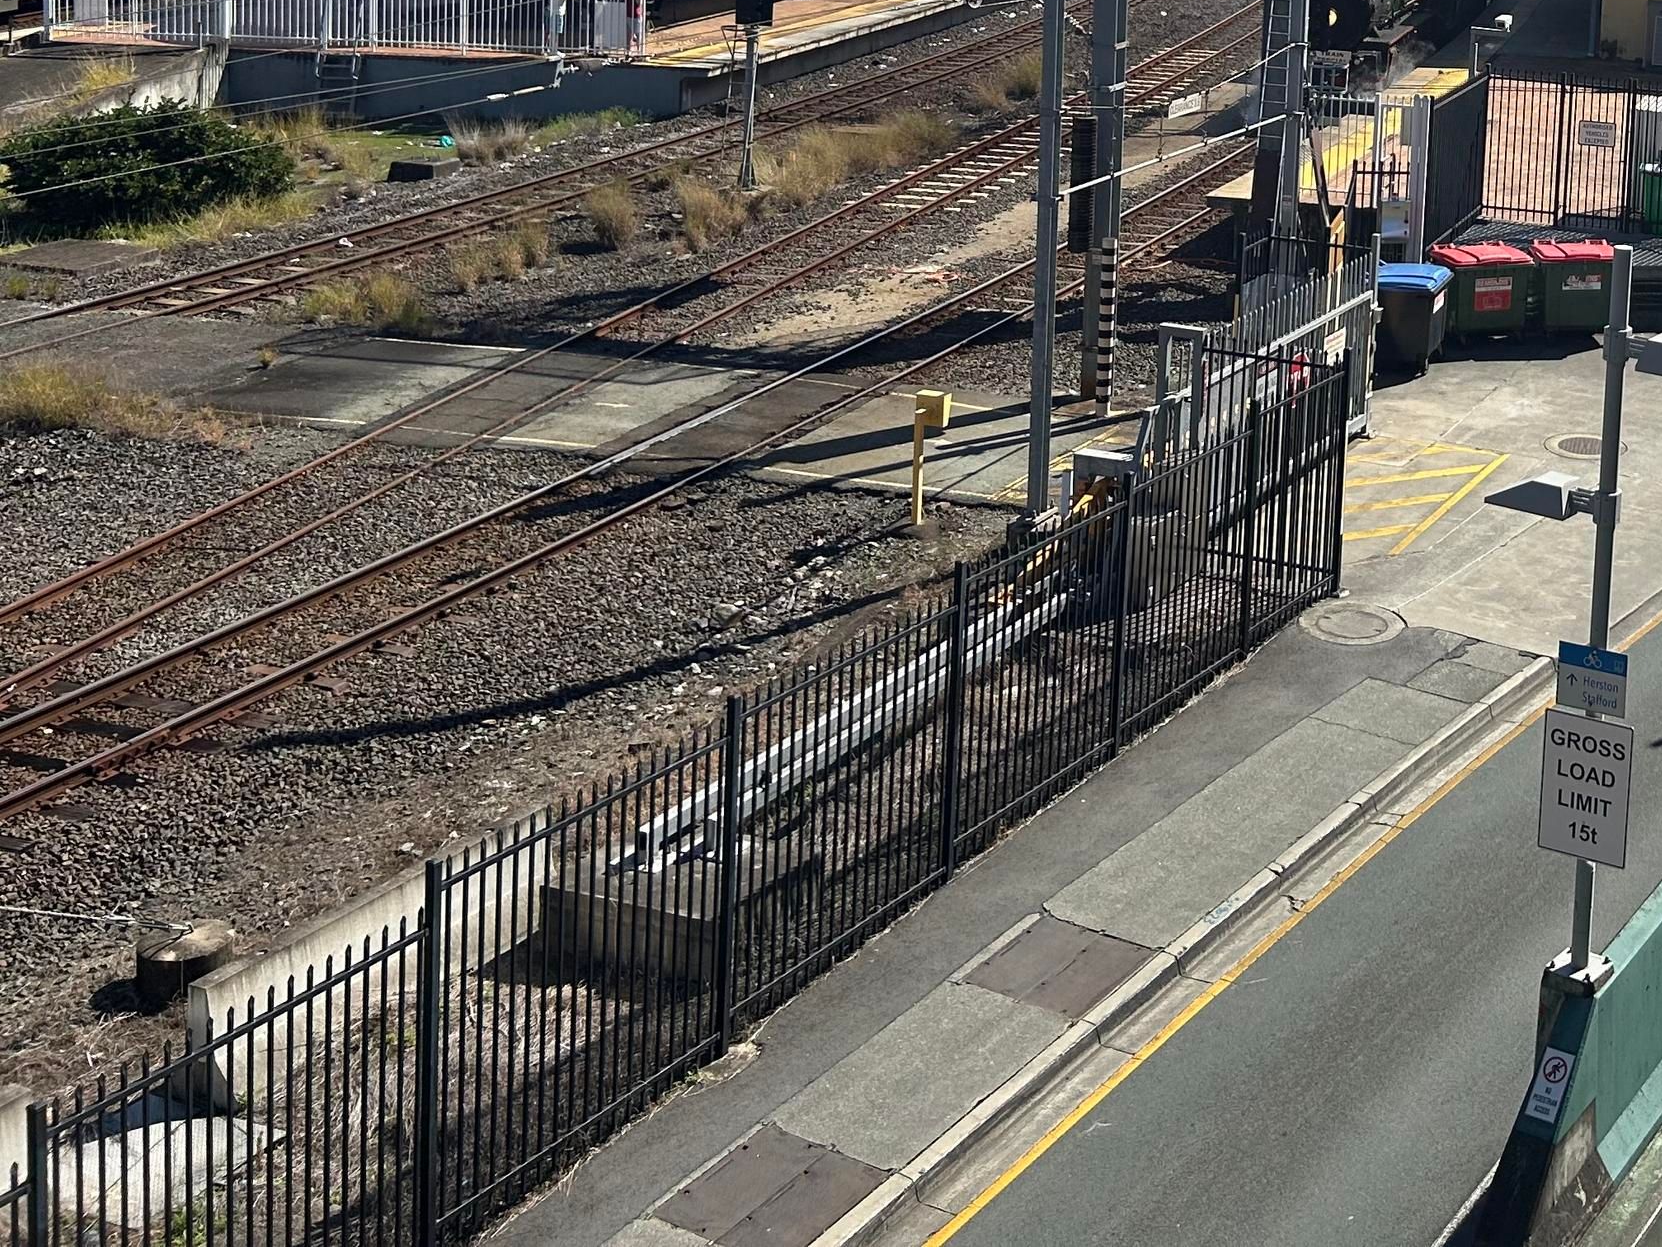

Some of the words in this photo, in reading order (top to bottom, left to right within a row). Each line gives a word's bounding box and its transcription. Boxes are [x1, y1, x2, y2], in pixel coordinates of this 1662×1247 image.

[1583, 676, 1619, 693] Herston
[1582, 692, 1617, 709] Stafford
[1550, 728, 1626, 761] GROSS
[1556, 758, 1616, 788] LOAD
[1557, 788, 1612, 817] LIMIT
[1568, 821, 1598, 844] 15t
